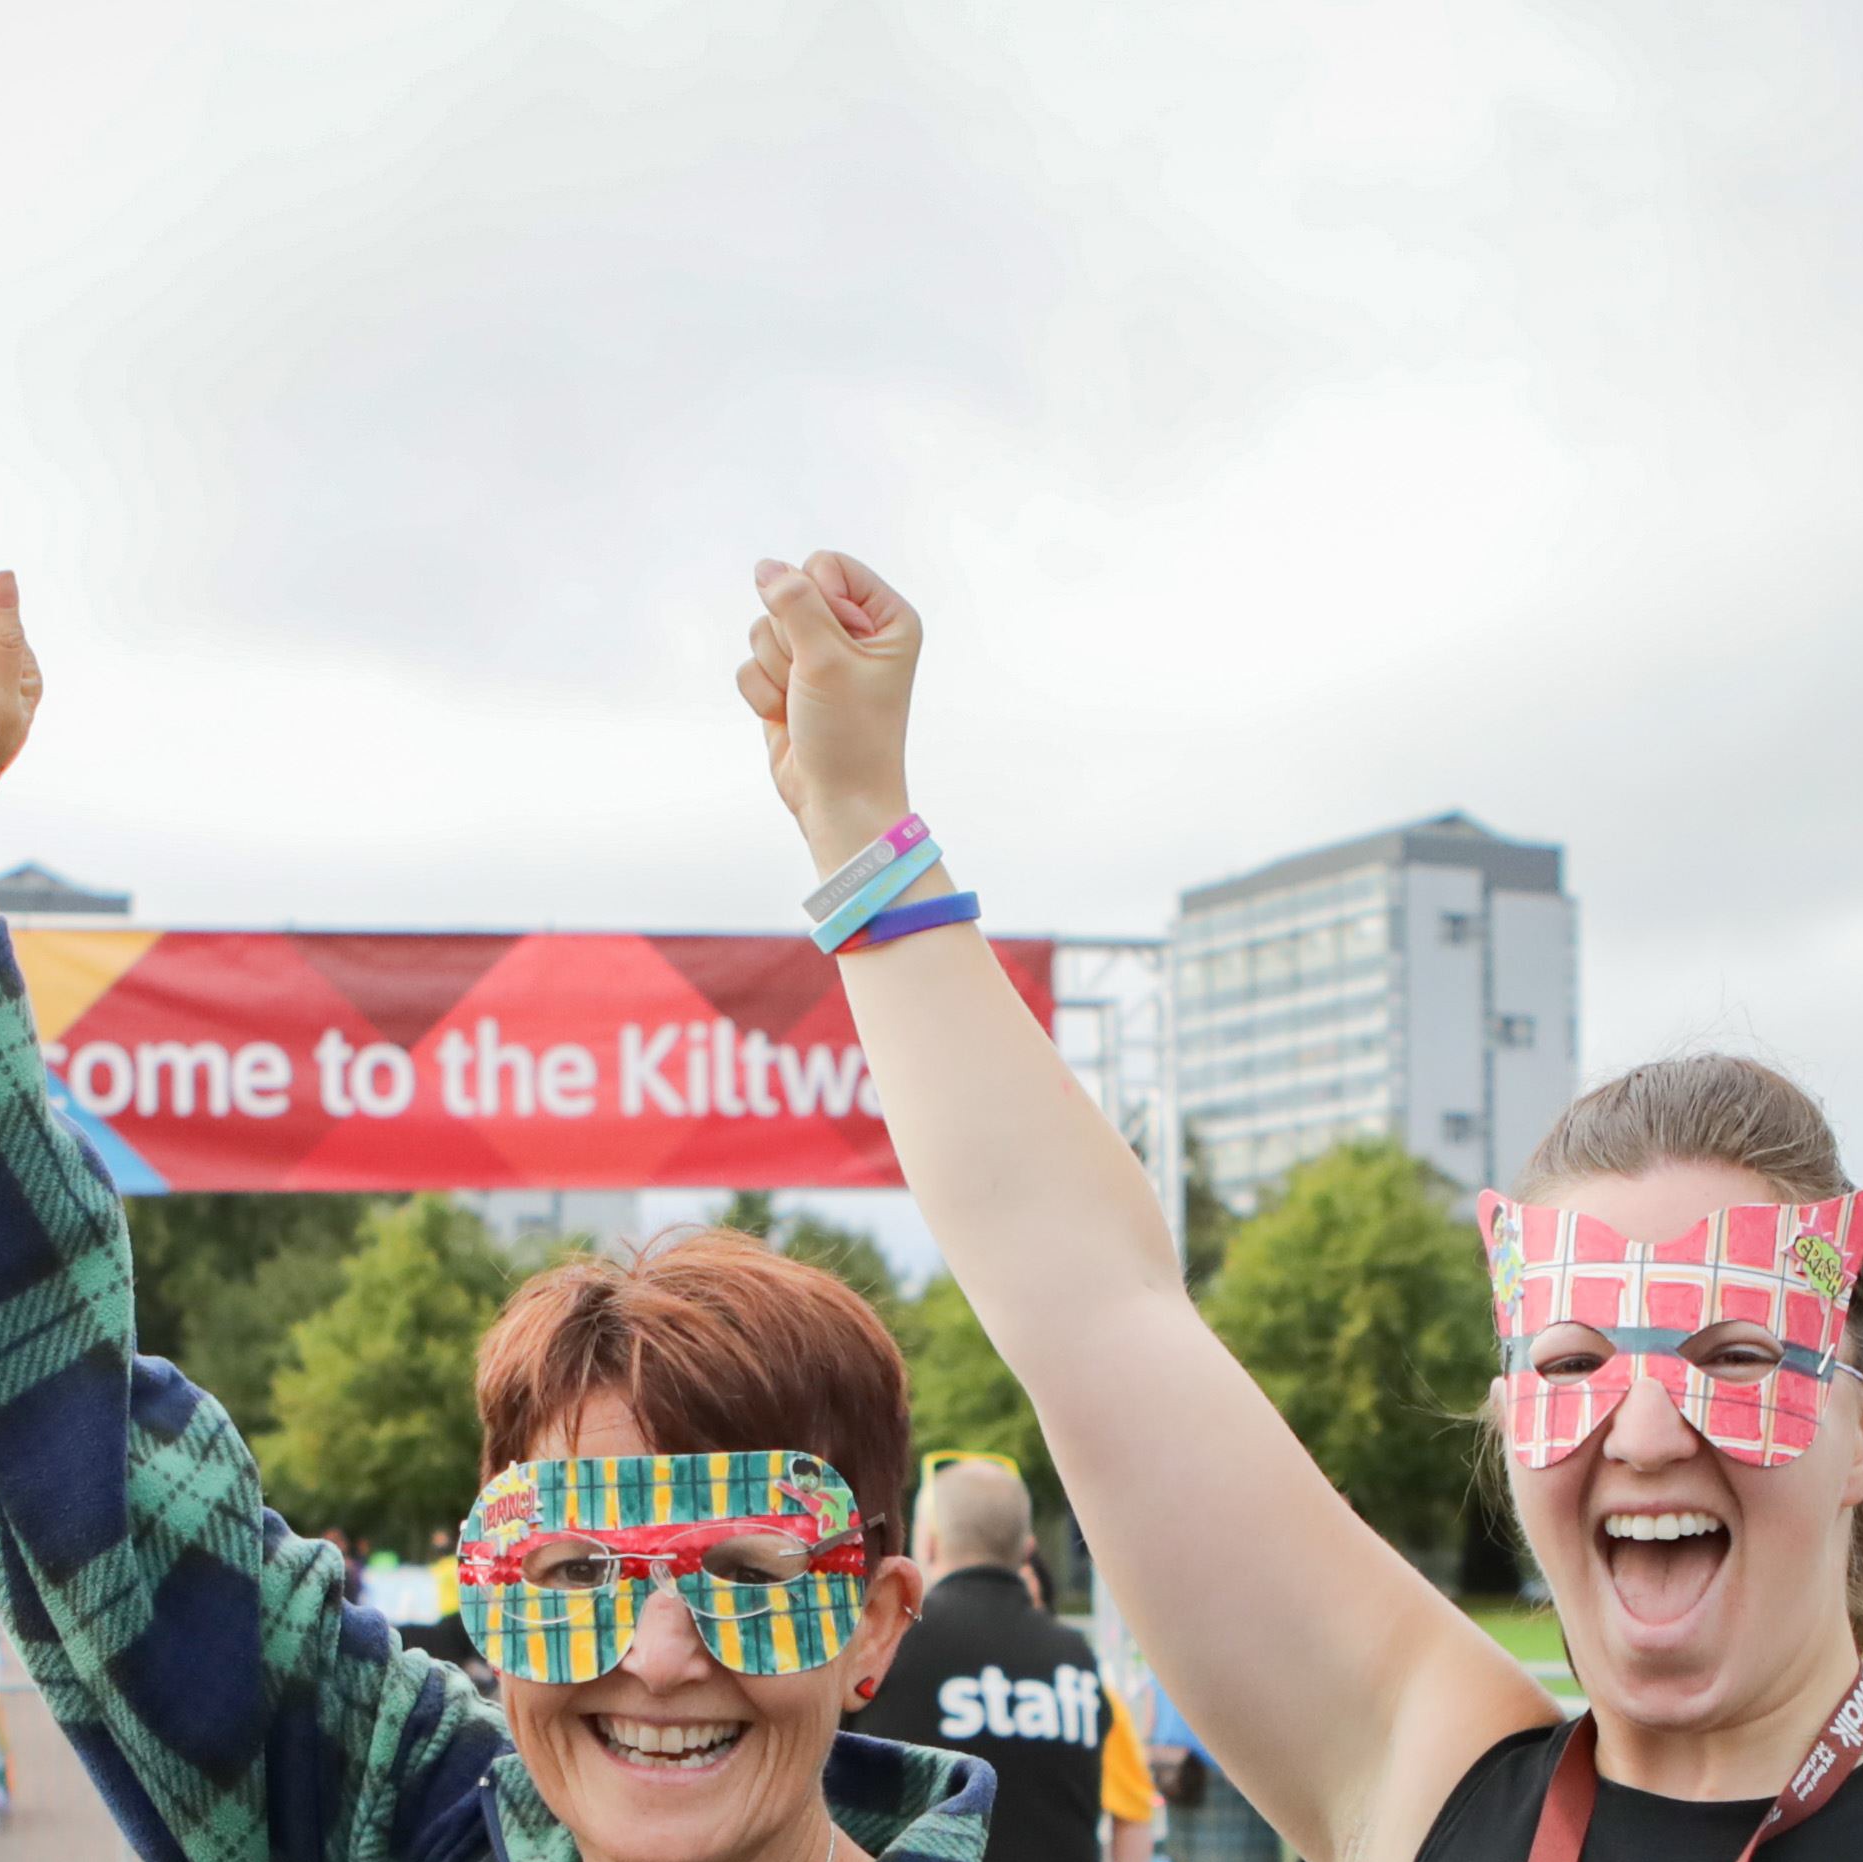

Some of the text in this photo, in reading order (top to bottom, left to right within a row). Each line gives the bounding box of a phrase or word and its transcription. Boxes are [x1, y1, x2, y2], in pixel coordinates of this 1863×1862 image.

[313, 1028, 417, 1118] to
[434, 1017, 598, 1118] the
[619, 1016, 886, 1119] Kiltw
[938, 1663, 1100, 1748] staff
